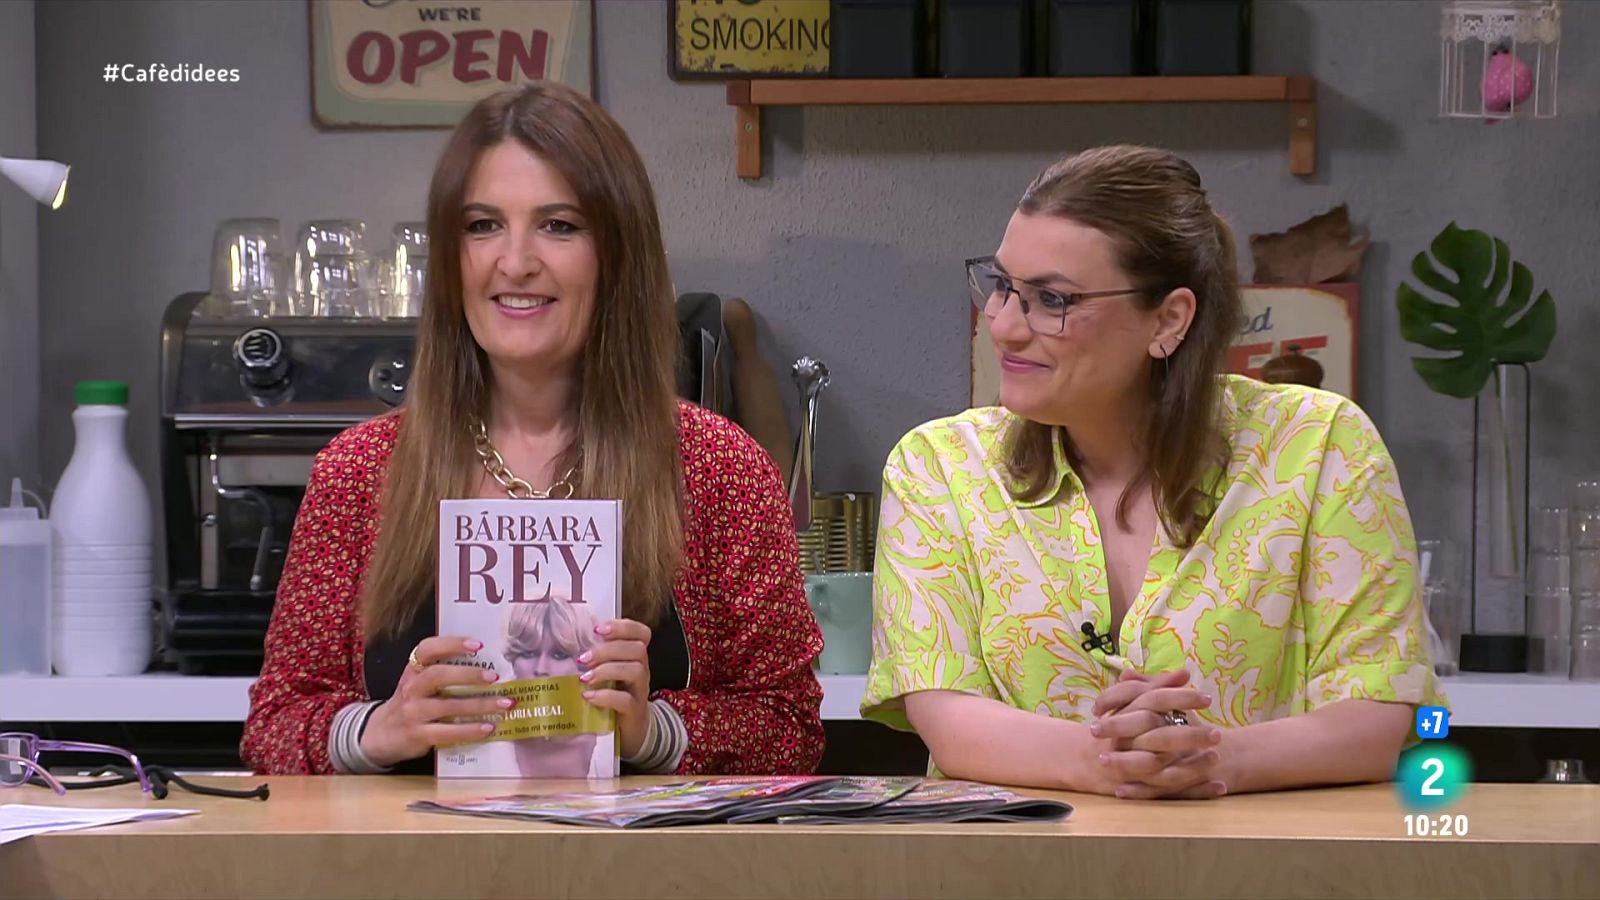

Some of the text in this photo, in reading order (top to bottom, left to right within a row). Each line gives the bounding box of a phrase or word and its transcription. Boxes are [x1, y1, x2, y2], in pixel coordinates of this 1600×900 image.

[418, 8, 481, 21] WE'RE
[346, 29, 549, 84] OPEN
[455, 511, 602, 542] BÁRBARA
[454, 543, 602, 604] REY
